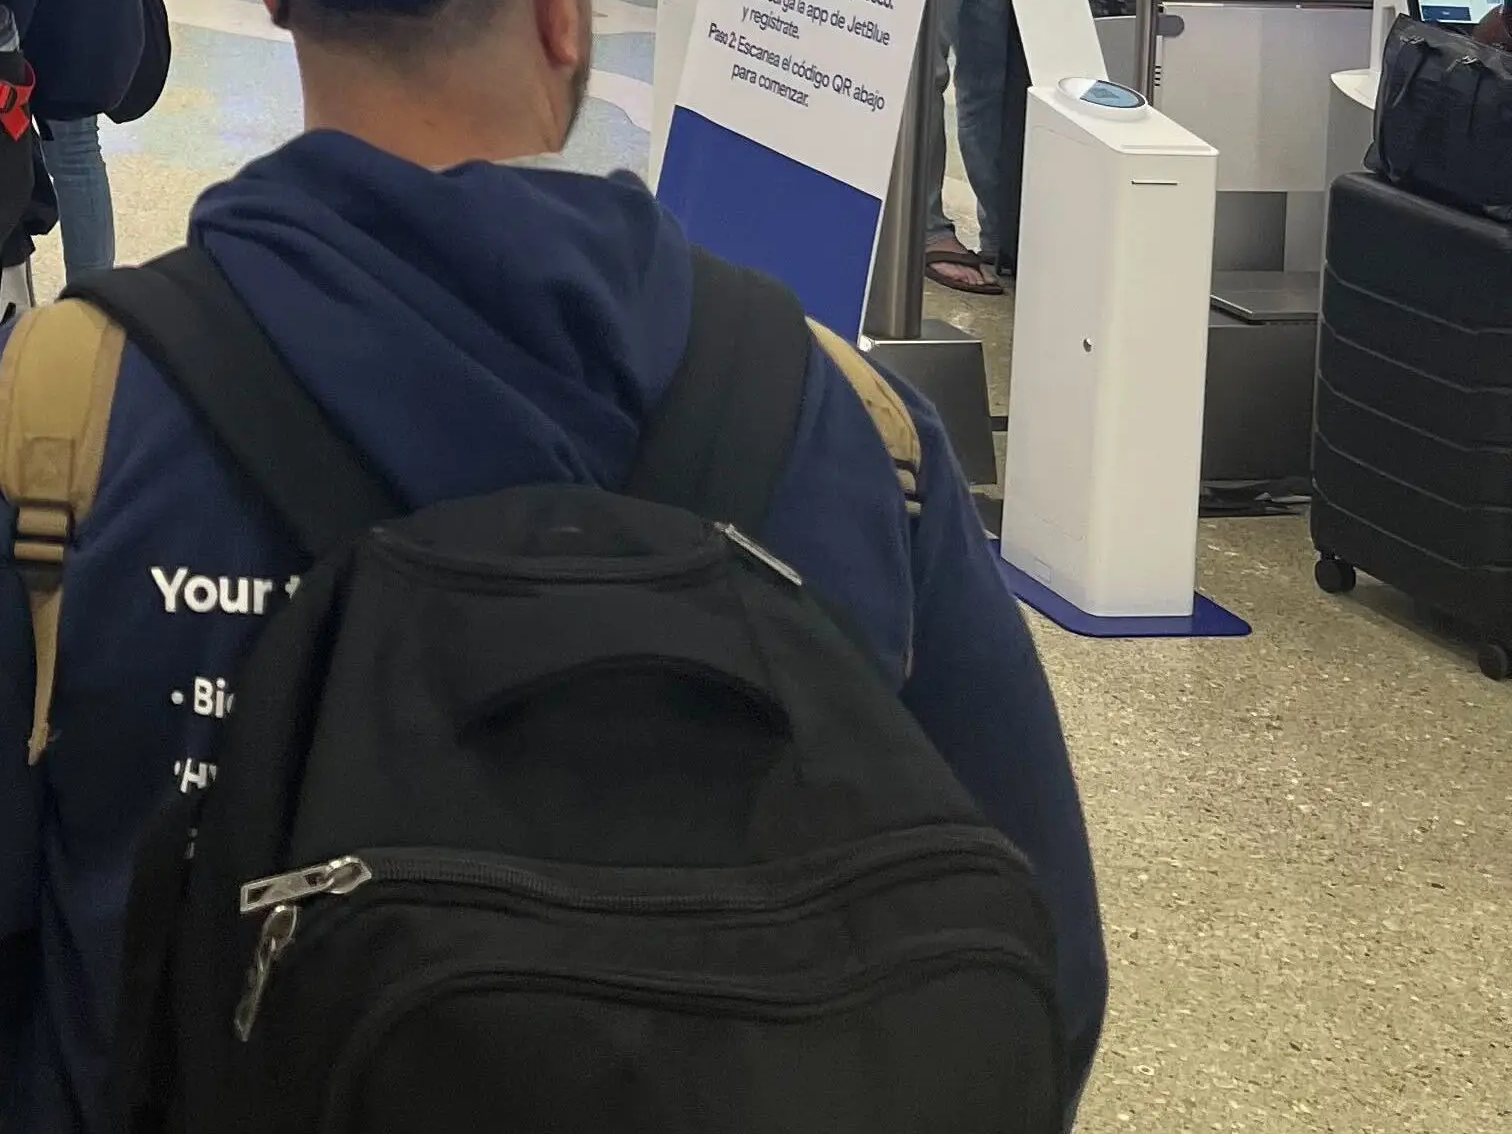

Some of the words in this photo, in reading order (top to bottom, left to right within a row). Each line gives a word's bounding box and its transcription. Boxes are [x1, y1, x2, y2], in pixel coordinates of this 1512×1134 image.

[741, 5, 750, 22] y
[806, 4, 829, 26] app
[830, 10, 846, 30] de
[846, 15, 891, 46] JetBlue
[708, 22, 729, 45] Paso
[728, 31, 737, 50] 2:
[737, 35, 781, 68] Escanea
[781, 54, 792, 71] el
[791, 59, 830, 90] código
[832, 73, 853, 97] QR
[852, 85, 885, 113] abajo
[731, 63, 757, 84] para
[758, 74, 809, 108] comenzar.
[150, 566, 274, 615] Your
